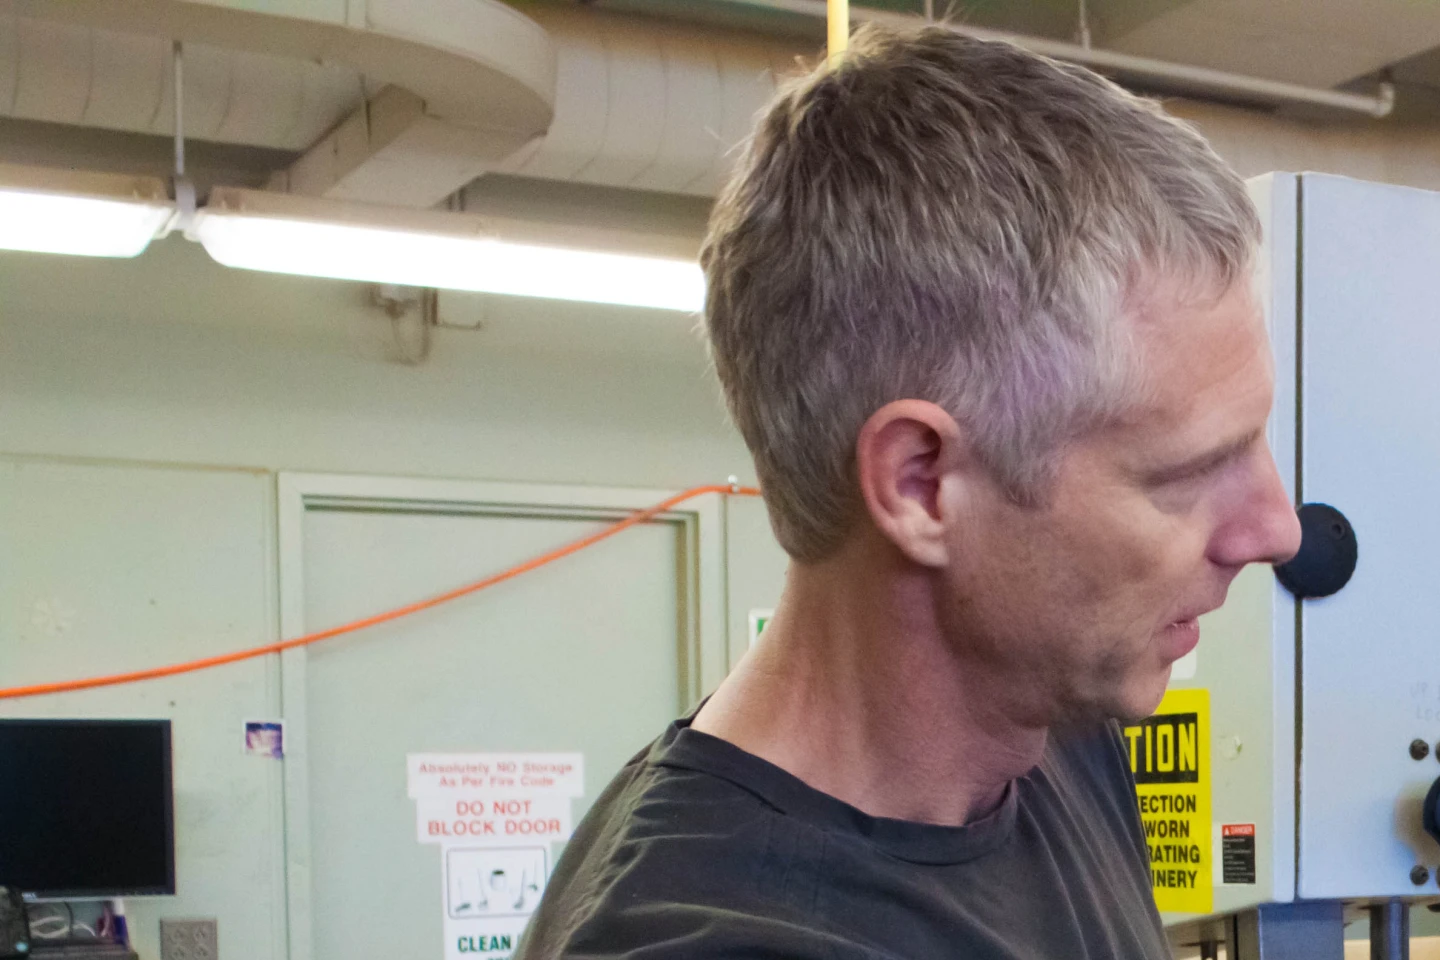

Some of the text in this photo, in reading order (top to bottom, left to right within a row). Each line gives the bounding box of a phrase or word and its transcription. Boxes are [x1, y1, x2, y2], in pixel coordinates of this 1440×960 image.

[1124, 723, 1196, 773] TION
[419, 761, 573, 776] Absolutely NO Storage
[439, 776, 555, 787] As Per Fire Code
[456, 800, 532, 816] DO NOT
[1138, 794, 1197, 813] ECTION
[428, 818, 561, 836] BLOCK DOOR
[1144, 819, 1190, 838] WORN
[1149, 844, 1200, 864] ATING
[1152, 869, 1198, 888] INERY
[458, 935, 511, 952] CLEAN
